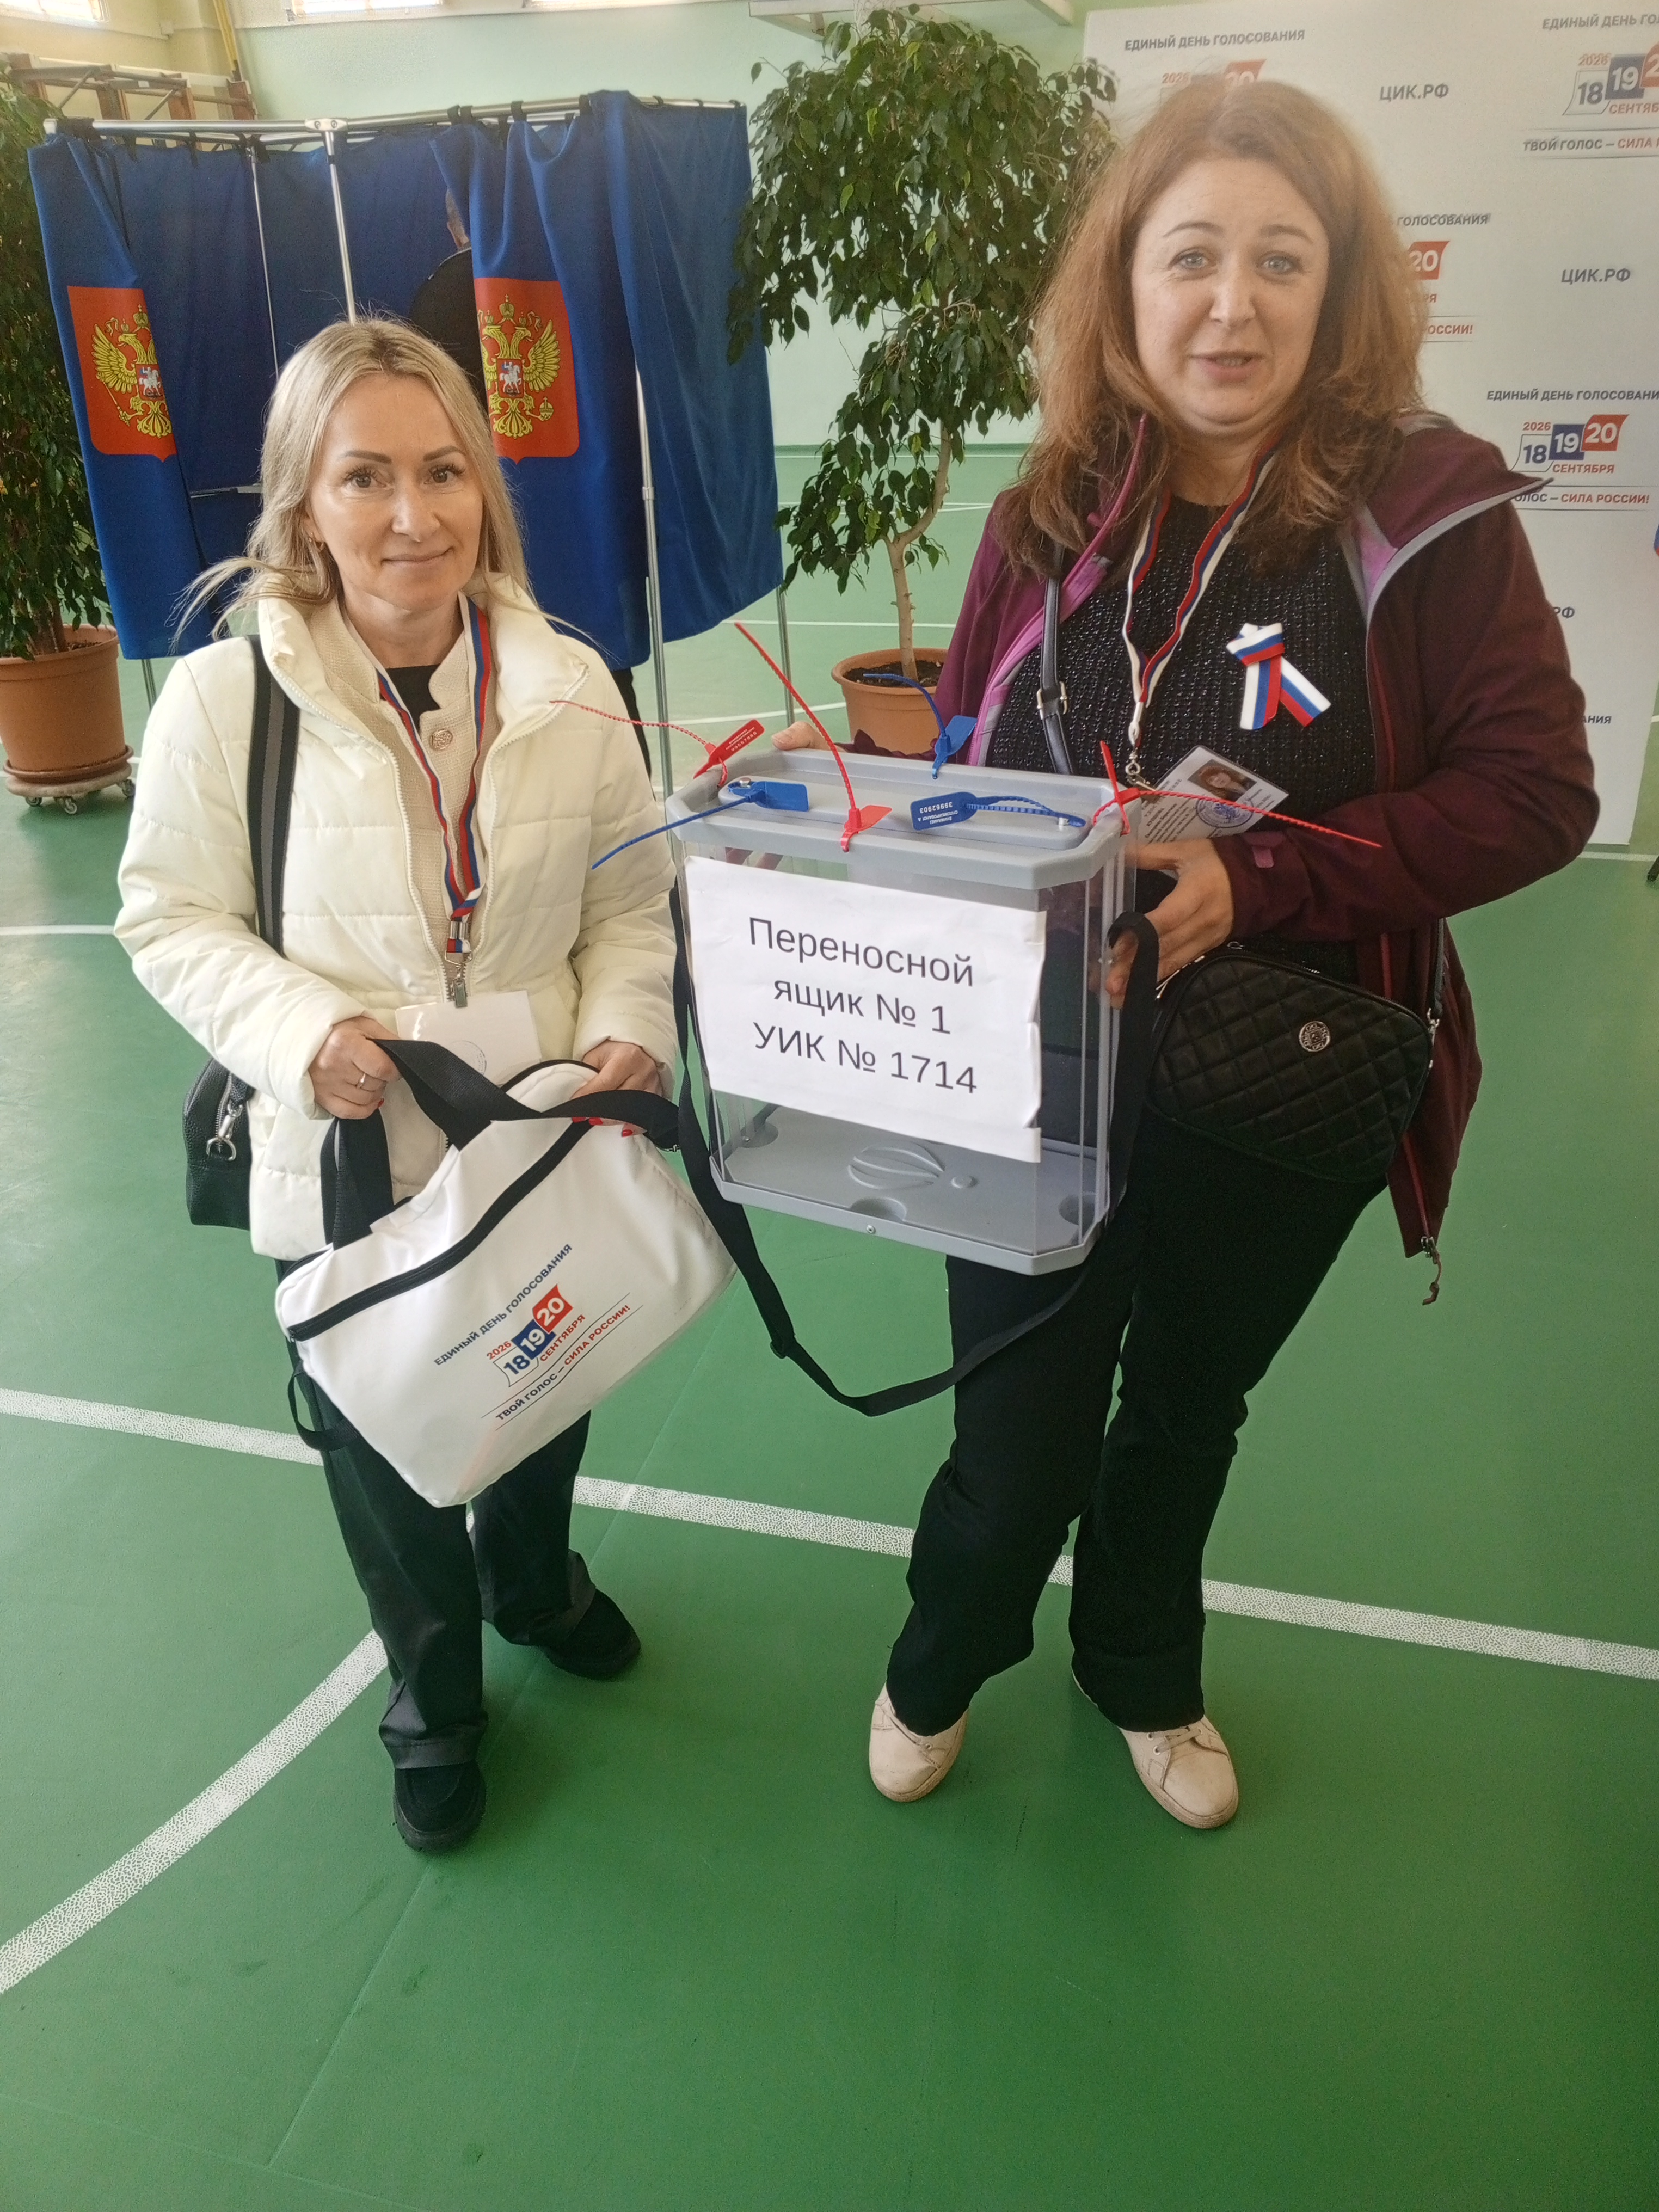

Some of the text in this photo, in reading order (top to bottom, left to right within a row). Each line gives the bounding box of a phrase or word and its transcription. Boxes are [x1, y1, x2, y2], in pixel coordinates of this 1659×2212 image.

[1542, 14, 1599, 29] ЕДИНЫЙ
[1601, 15, 1637, 28] ДЕНЬ
[1125, 30, 1305, 52] ЕДИНЫЙ ДЕНЬ ГОЛОСОВАНИЯ
[1578, 56, 1659, 105] 18 19 2
[1379, 83, 1449, 102] ЦИК.РФ
[1609, 103, 1659, 114] СЕНТЯБ
[1523, 136, 1558, 151] ТВОЙ
[1560, 139, 1603, 150] ГОЛОС
[1618, 138, 1652, 149] СИЛА
[1397, 213, 1490, 226] ГОЛОСОВАНИЯ
[1409, 250, 1439, 272] 20
[1562, 268, 1631, 285] ЦИК.РФ
[1428, 325, 1473, 335] ОССИИ!
[1487, 388, 1659, 401] ЕДИНЫЙ ДЕНЬ ГОЛОСОВАНИ
[1522, 422, 1551, 431] 2026
[1523, 423, 1617, 464] 18 19 20
[1552, 464, 1615, 474] СЕНТЯБРЯ
[1515, 493, 1547, 503] ОЛОС
[1561, 494, 1593, 503] СИЛА
[1596, 494, 1649, 503] РОССИИ!
[919, 802, 953, 814] 39962903
[749, 917, 973, 987] Переносной
[773, 980, 950, 1034] ящик № 1
[753, 1022, 977, 1094] УИК № 1714
[434, 1244, 572, 1365] ЕДИНЫЙ ДЕНЬ ГОЛОСОВАНИЯ
[503, 1297, 564, 1375] 18 19 20
[540, 1314, 586, 1362] СЕНТЯБРЯ
[487, 1341, 512, 1360] 2026
[495, 1398, 525, 1421] ТВОЙ
[524, 1373, 557, 1400] ГОЛОС
[564, 1341, 589, 1365] СИЛА
[588, 1305, 630, 1341] РОССИИ!
